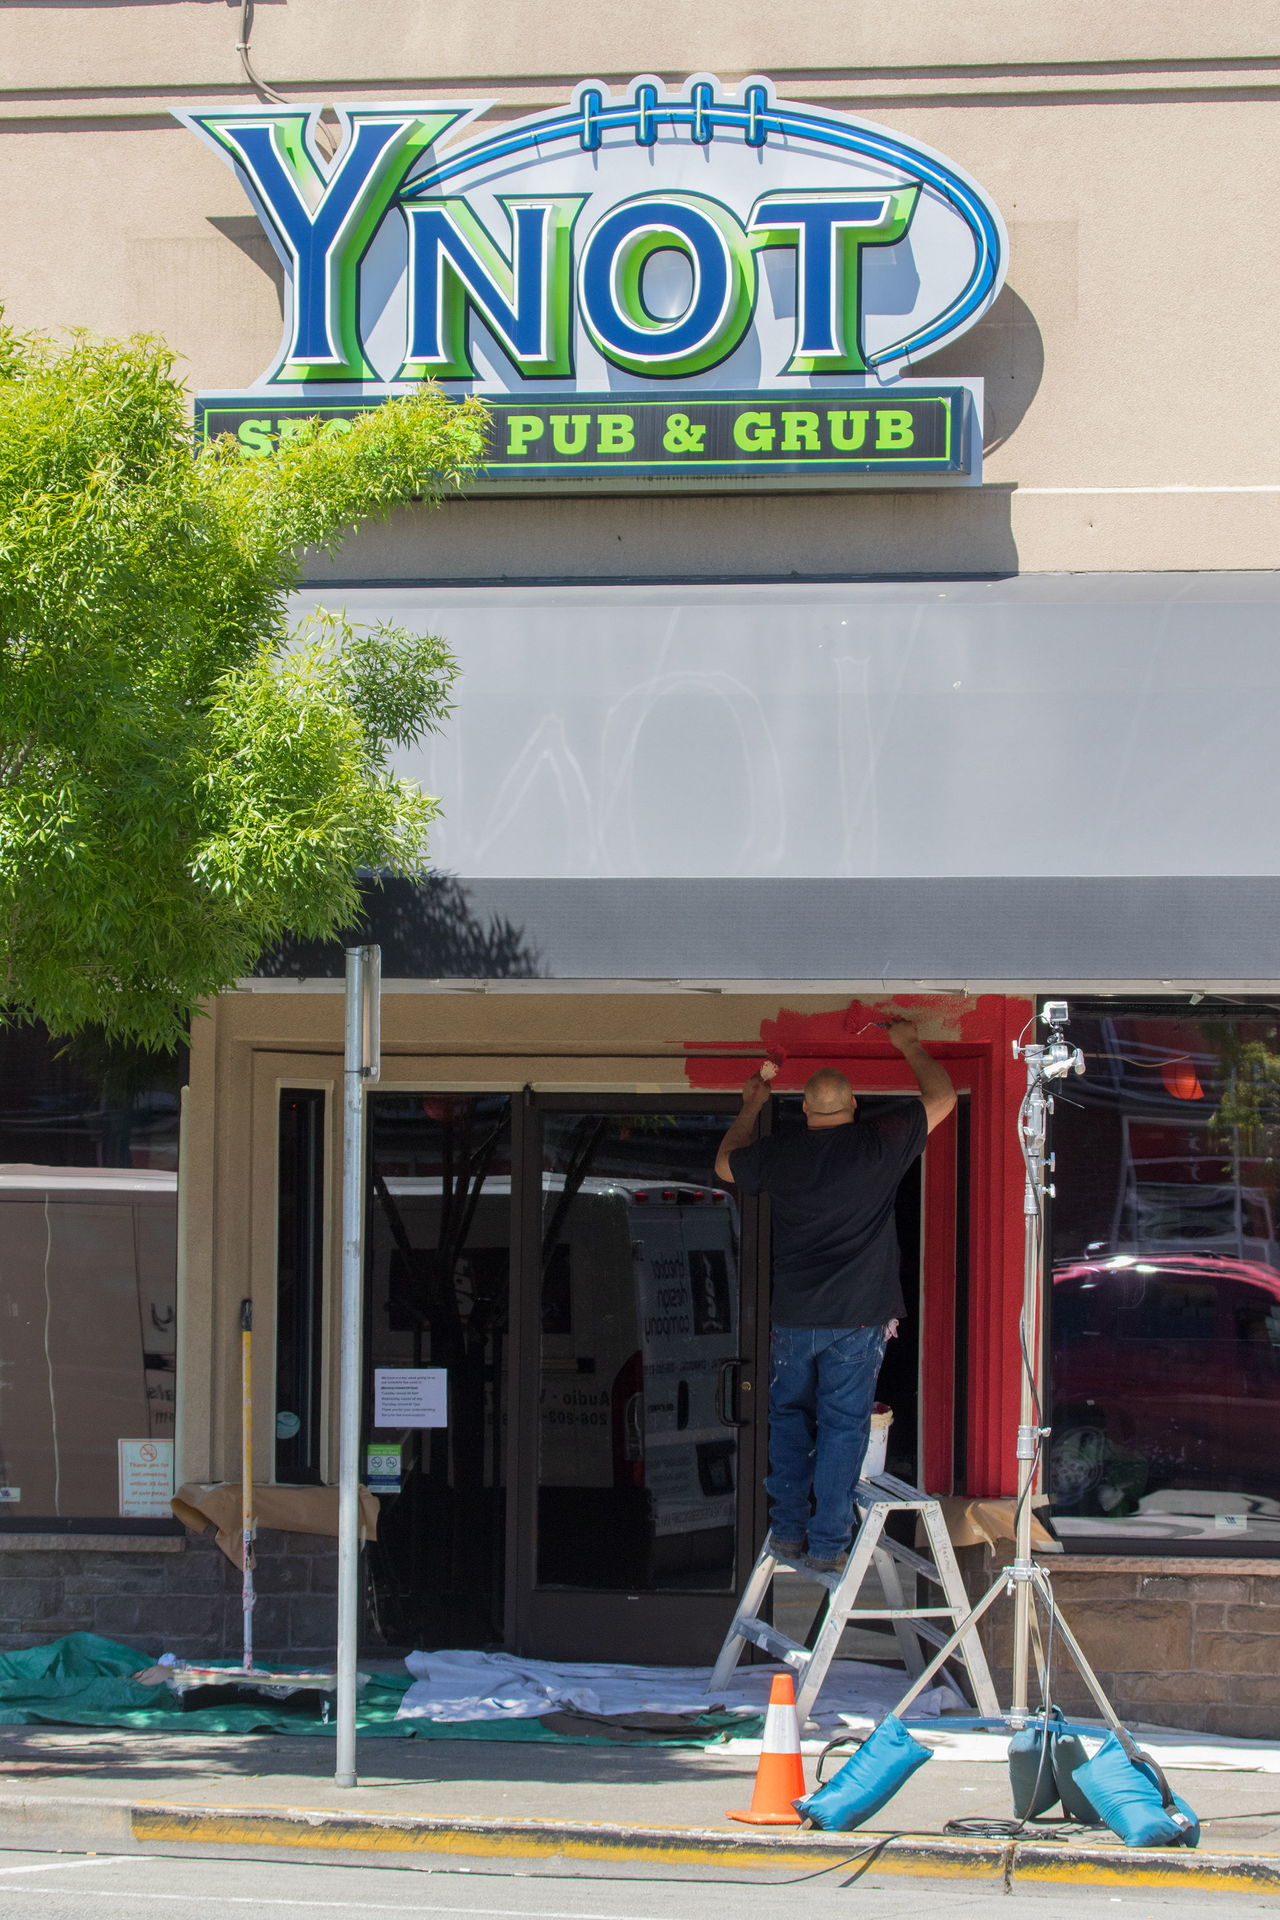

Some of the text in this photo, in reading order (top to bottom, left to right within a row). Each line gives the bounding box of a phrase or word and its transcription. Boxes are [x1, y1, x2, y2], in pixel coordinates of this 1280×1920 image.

[189, 109, 923, 383] YNOT
[506, 414, 635, 454] PUB
[662, 413, 706, 452] &
[733, 410, 914, 452] GRUB
